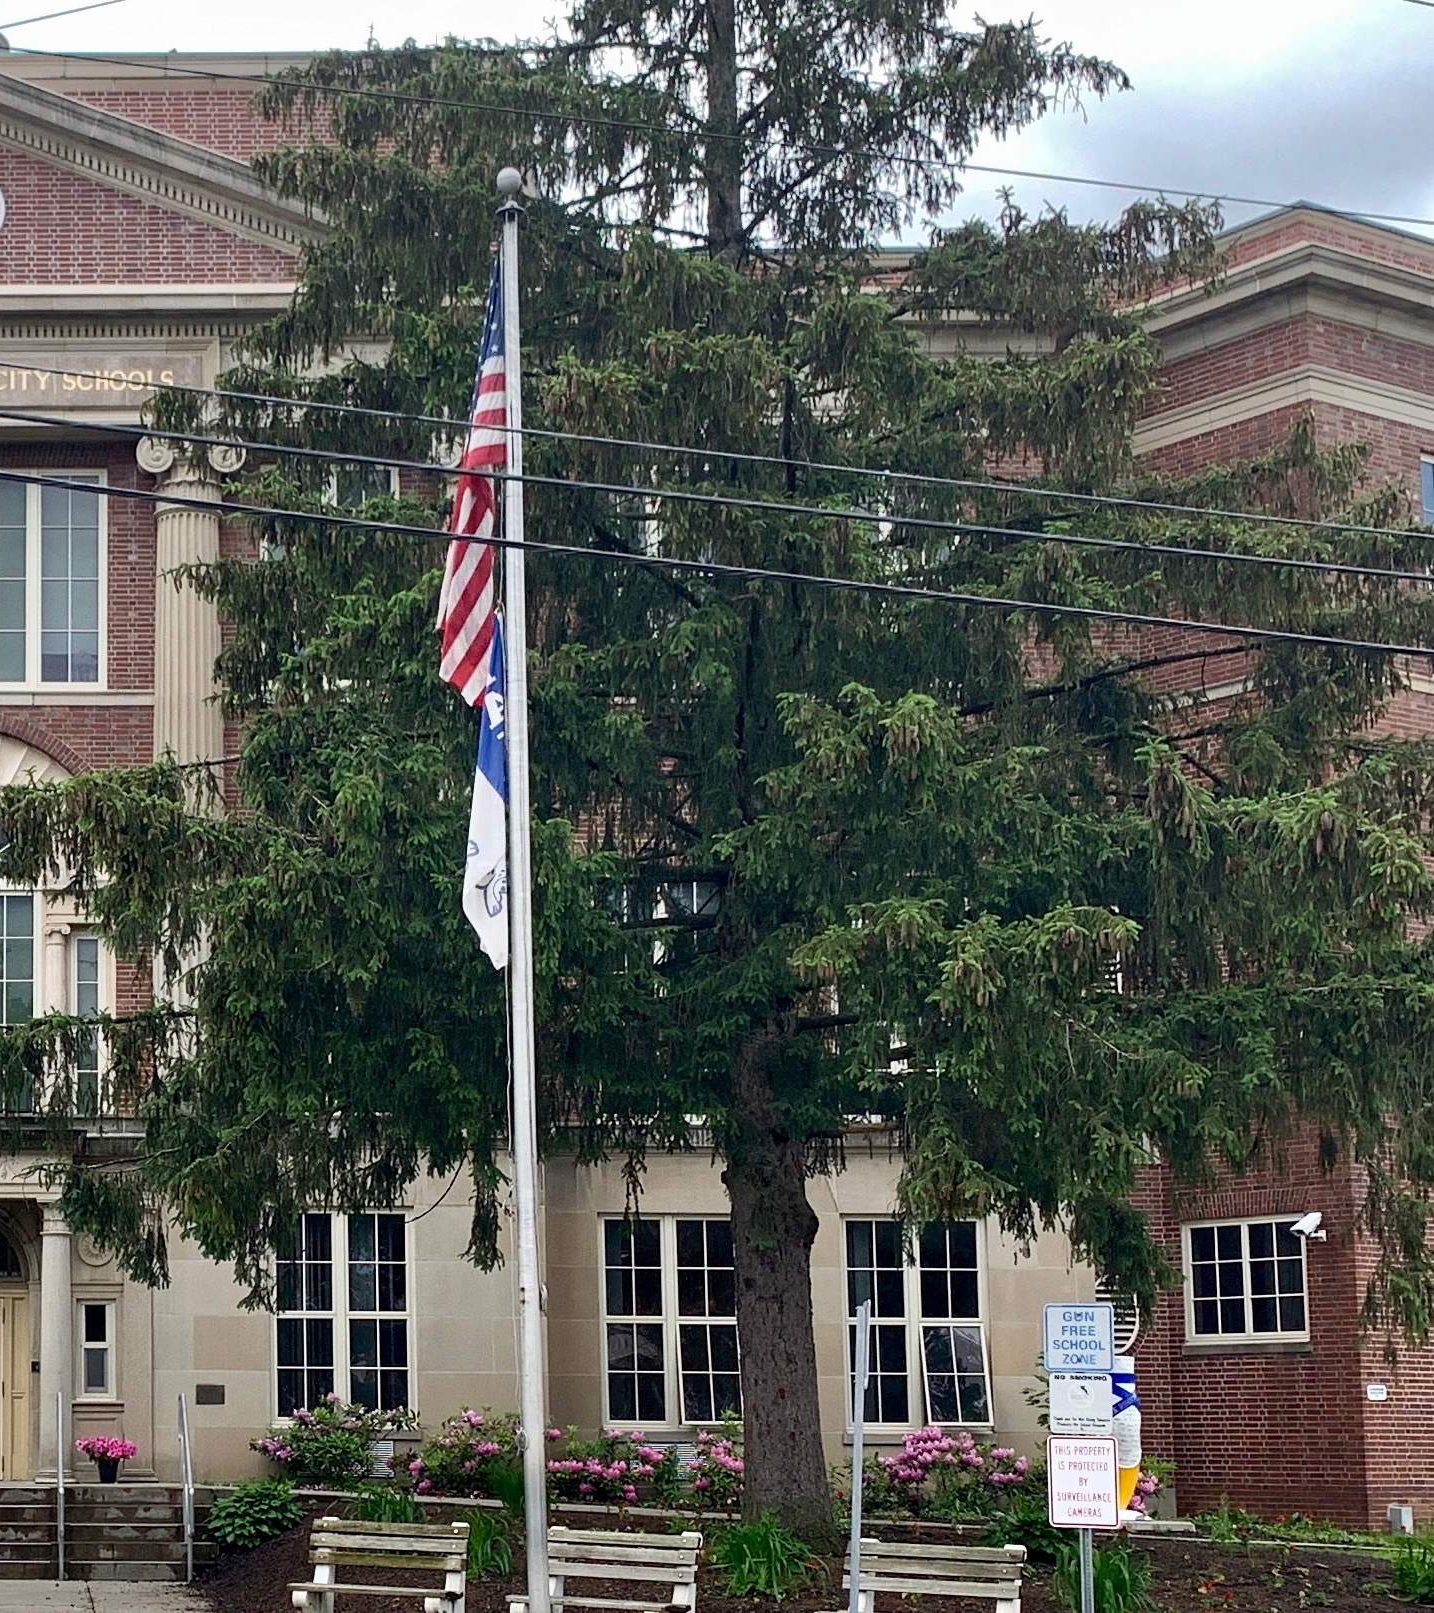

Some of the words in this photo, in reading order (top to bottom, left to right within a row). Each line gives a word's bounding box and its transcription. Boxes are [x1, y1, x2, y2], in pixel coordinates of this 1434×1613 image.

[62, 370, 174, 391] SCHOOLS
[1062, 1311, 1095, 1322] GUN
[1061, 1325, 1096, 1336] FREE
[1052, 1339, 1106, 1350] SCHOOL
[1062, 1353, 1096, 1365] ZONE
[1054, 1446, 1071, 1455] THIS
[1074, 1446, 1111, 1456] PROPERTY
[1058, 1461, 1065, 1470] IS
[1068, 1461, 1109, 1471] PROTECTED
[1078, 1477, 1089, 1486] BY
[1056, 1492, 1112, 1502] SURVEILLANCE
[1067, 1507, 1102, 1517] CAMERAS
